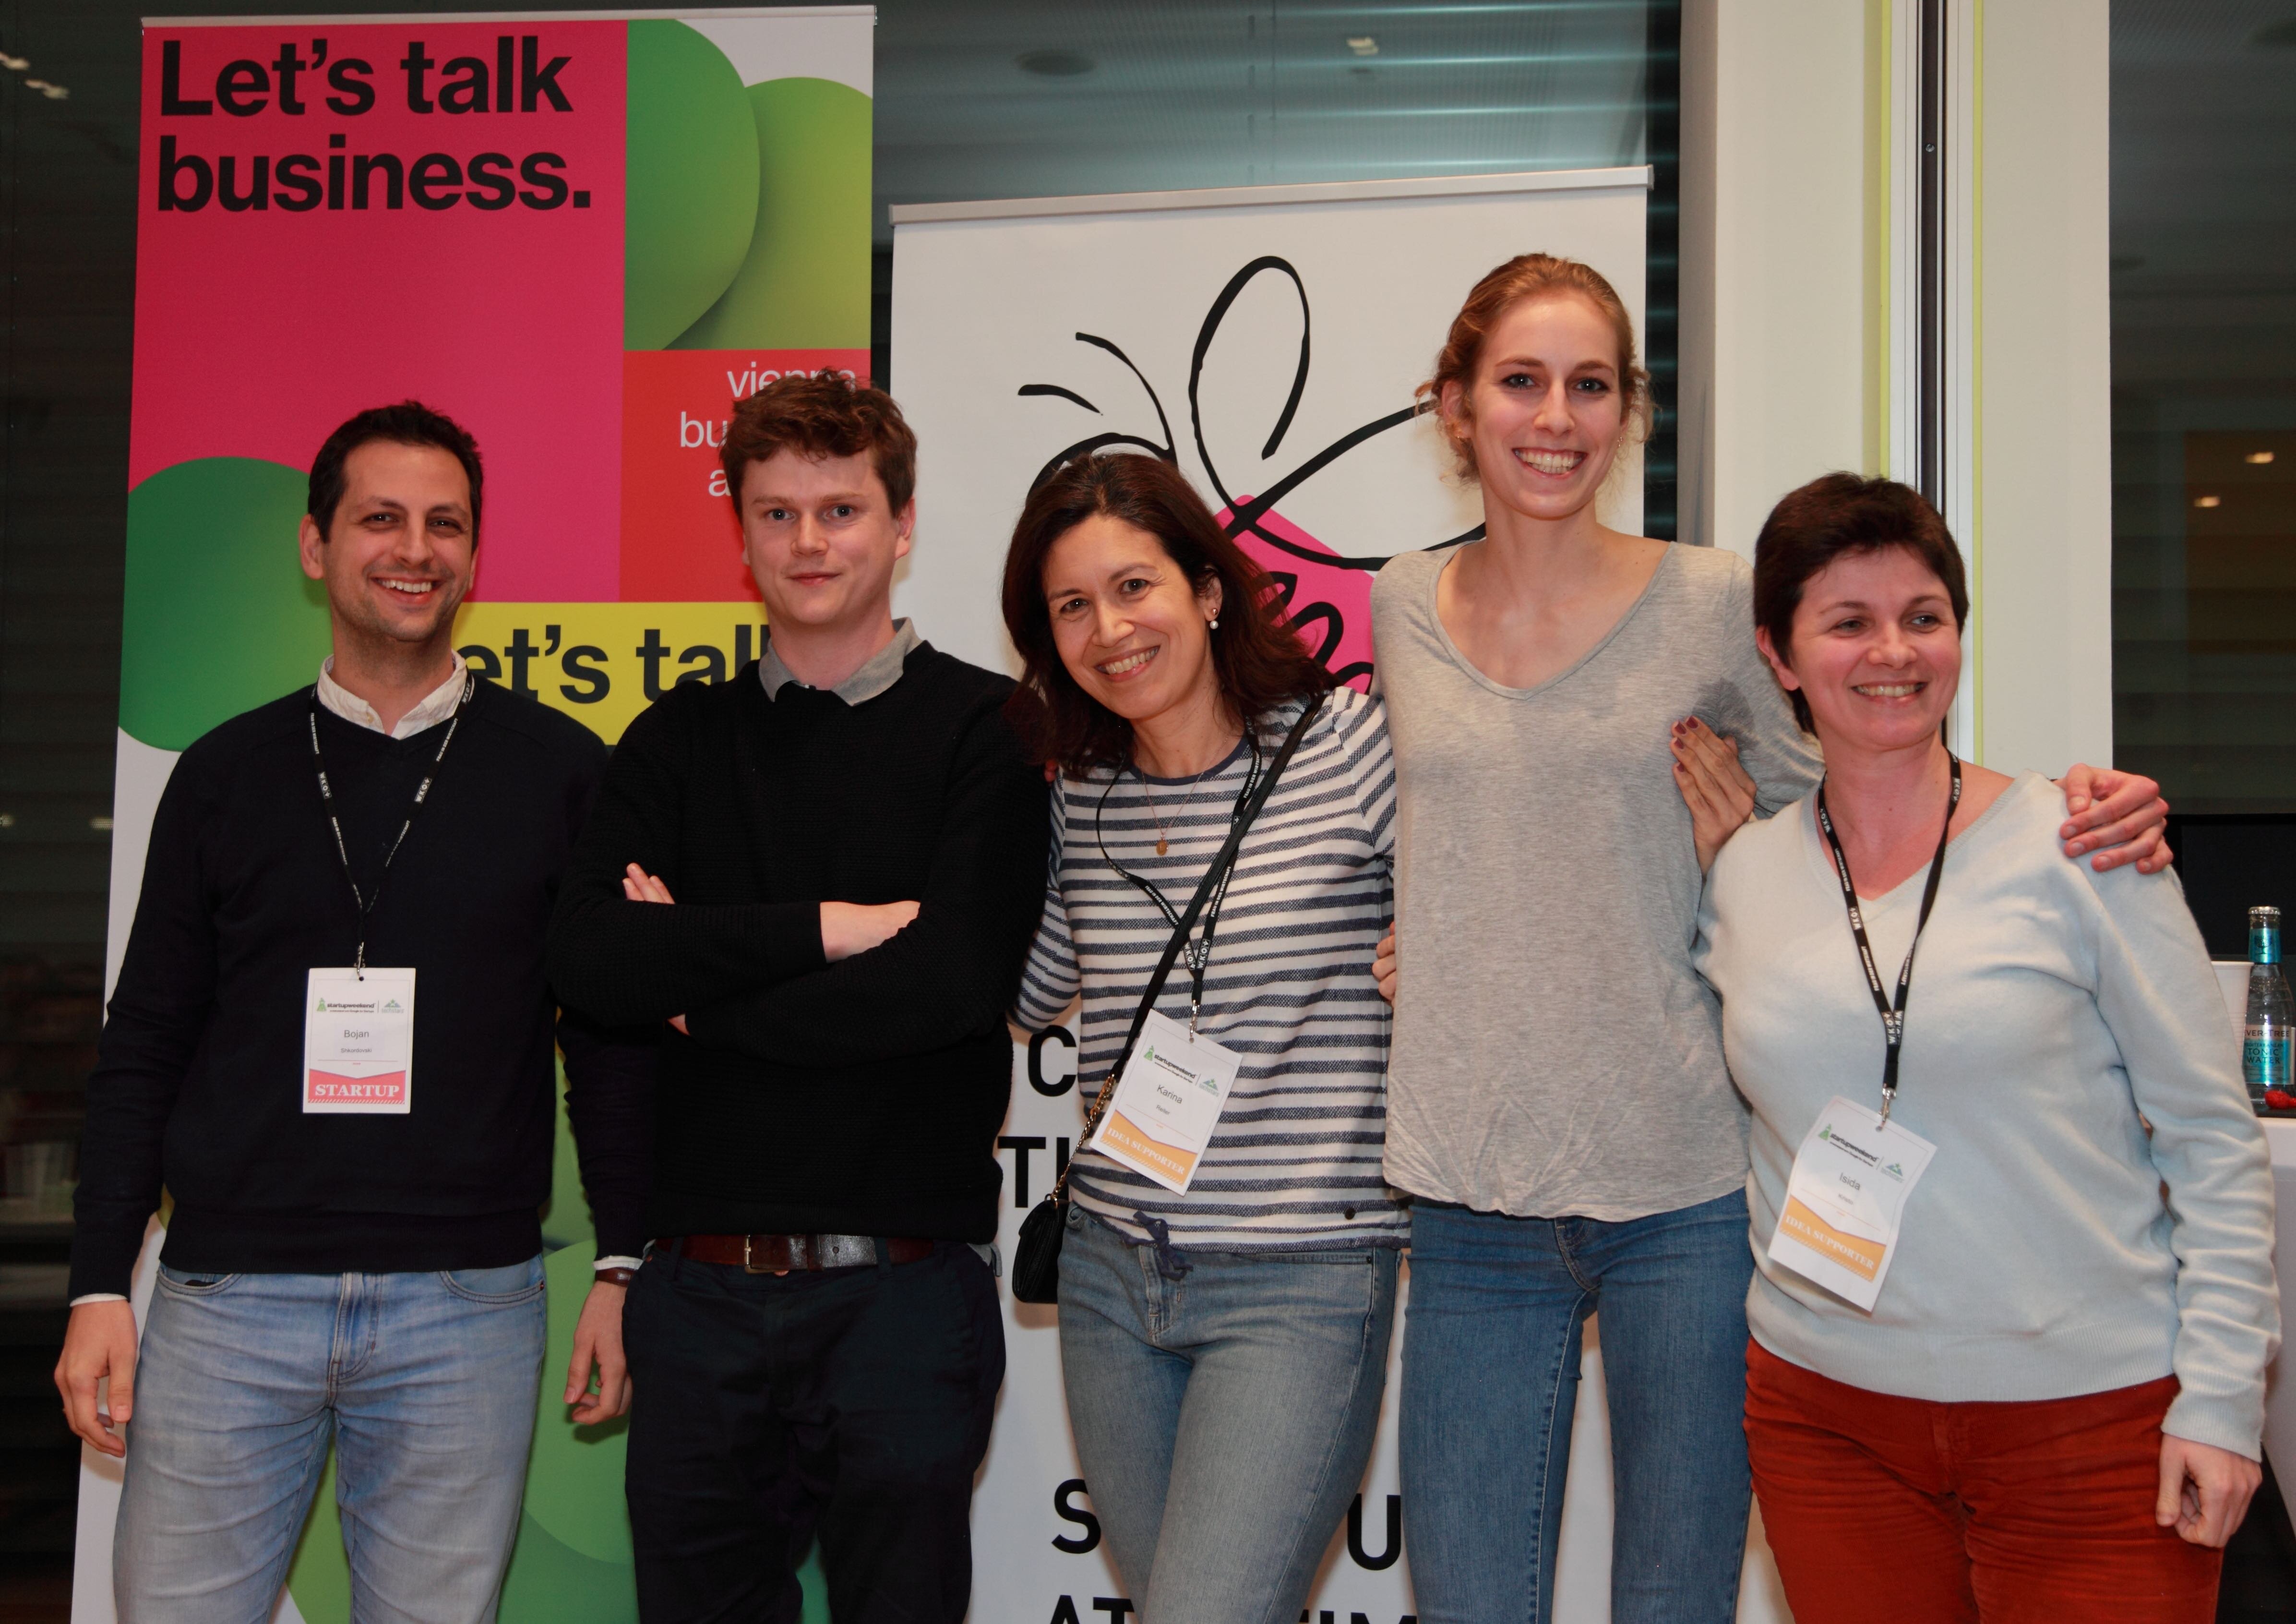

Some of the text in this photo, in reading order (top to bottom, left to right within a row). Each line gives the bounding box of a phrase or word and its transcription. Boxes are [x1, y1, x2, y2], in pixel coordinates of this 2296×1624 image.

[161, 36, 574, 118] Let’s talk
[158, 134, 591, 212] business.
[456, 625, 769, 704] et’s tal
[1220, 866, 1231, 892] WIRTSCHAFT
[1145, 885, 1153, 893] FRAU
[1160, 902, 1179, 926] WIRTSCHAFT
[1198, 948, 1208, 968] WKO
[344, 1030, 369, 1039] Bojan
[1886, 1019, 1896, 1044] WKO
[315, 1084, 400, 1097] STARTUP
[1157, 1085, 1183, 1104] Karina
[1108, 1128, 1185, 1175] IDEA SUPPORTER
[1840, 1172, 1861, 1191] Isida
[1786, 1215, 1874, 1270] IDEA SUPPORTER
